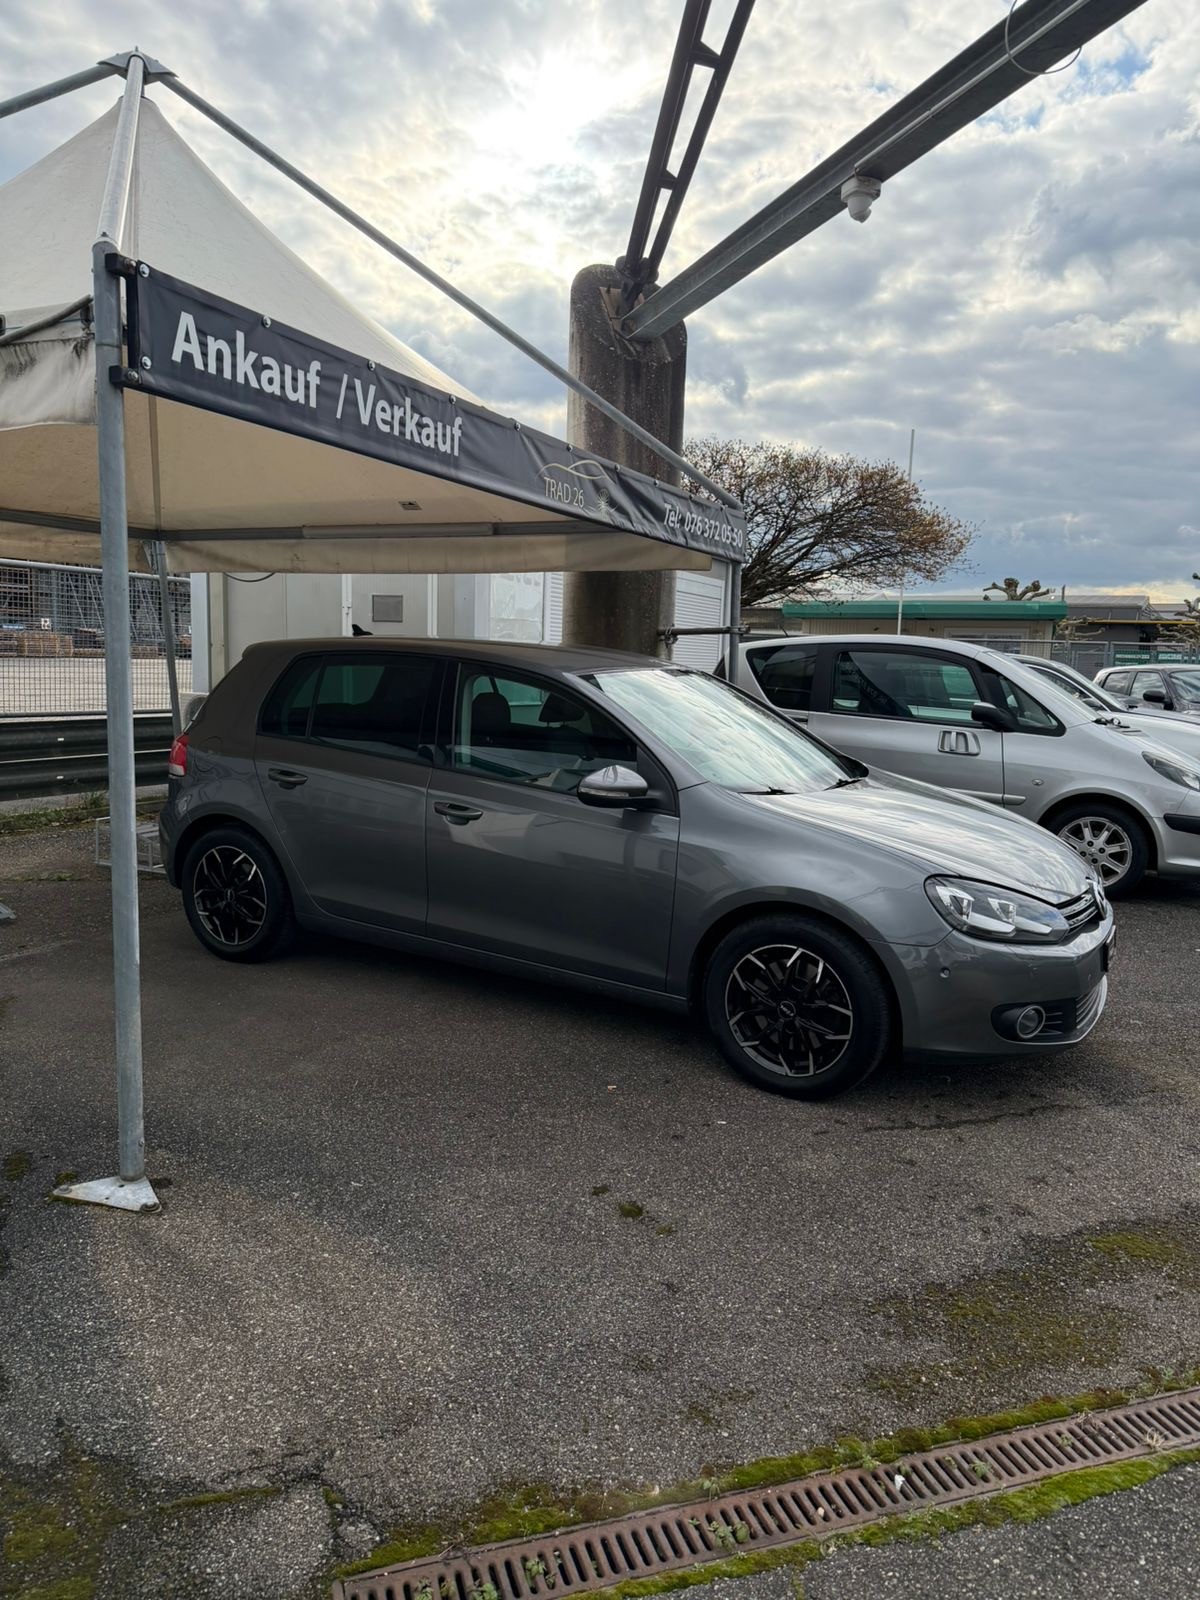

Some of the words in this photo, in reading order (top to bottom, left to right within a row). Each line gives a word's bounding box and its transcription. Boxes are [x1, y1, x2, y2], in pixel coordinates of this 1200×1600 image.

[171, 311, 322, 408] Ankauf
[543, 476, 571, 503] TRAD
[573, 487, 584, 508] 26
[663, 503, 682, 528] Tel:
[684, 511, 703, 536] 076
[704, 518, 720, 541] 372
[721, 523, 732, 544] 05
[732, 527, 743, 548] 50
